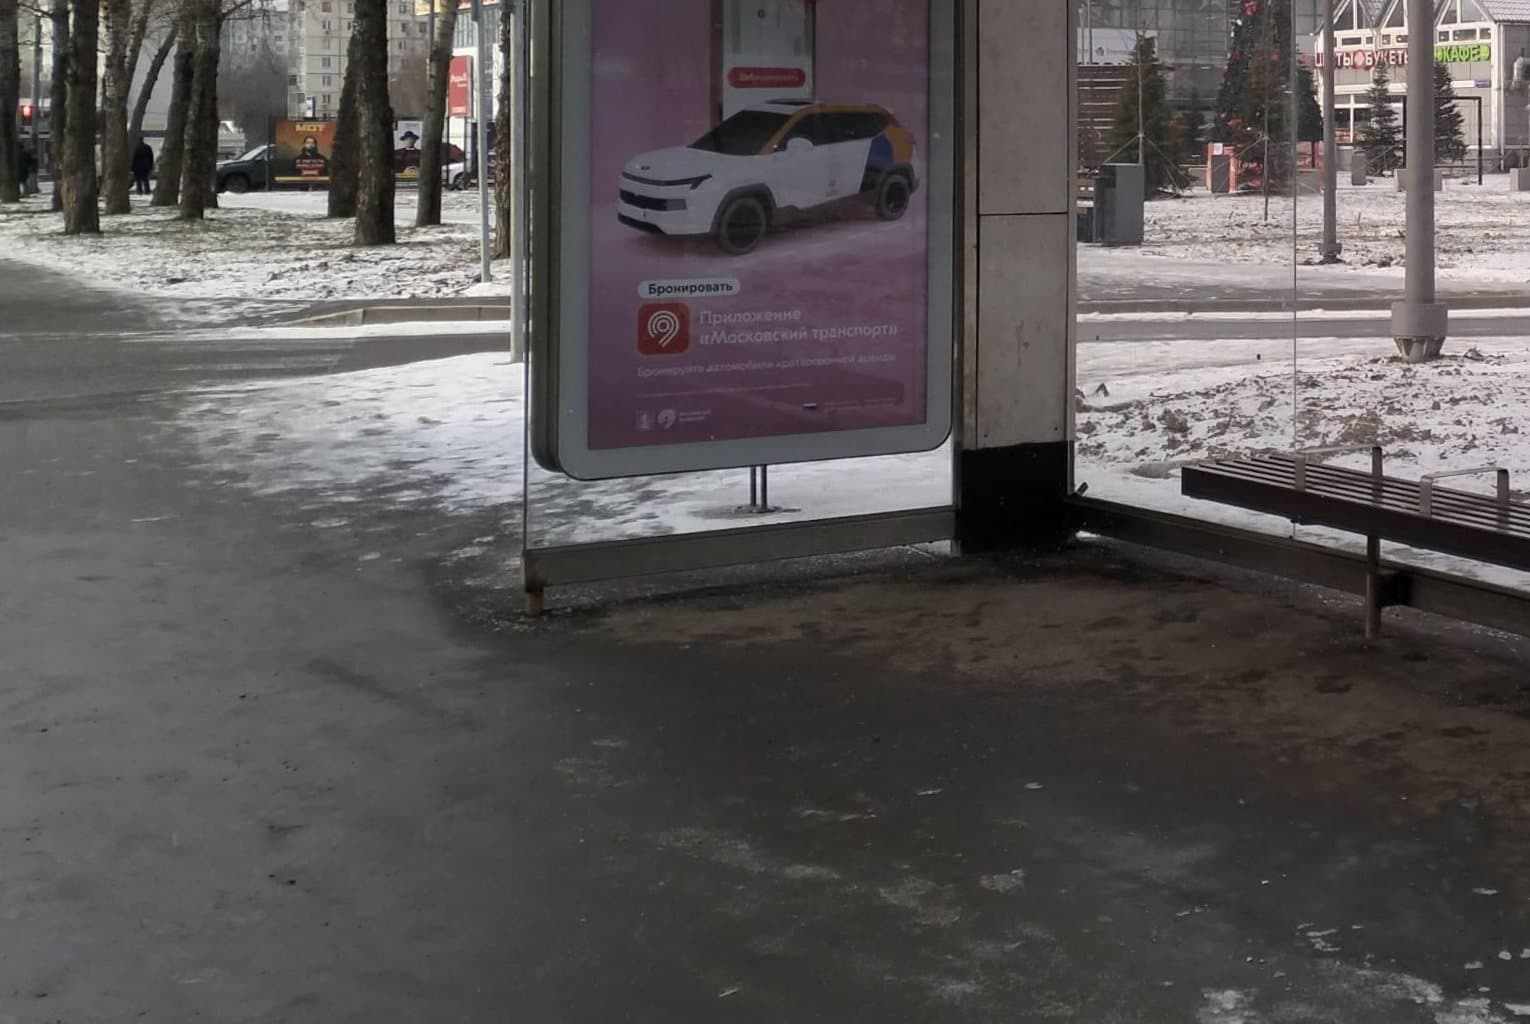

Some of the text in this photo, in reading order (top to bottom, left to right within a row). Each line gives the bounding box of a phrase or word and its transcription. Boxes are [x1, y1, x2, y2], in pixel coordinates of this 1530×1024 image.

[1314, 51, 1353, 68] ЦТЫ
[1443, 45, 1480, 62] КАФЕ
[648, 282, 734, 297] Бронировать
[699, 308, 802, 326] Приложение
[699, 323, 898, 346] «Московский транспорт»
